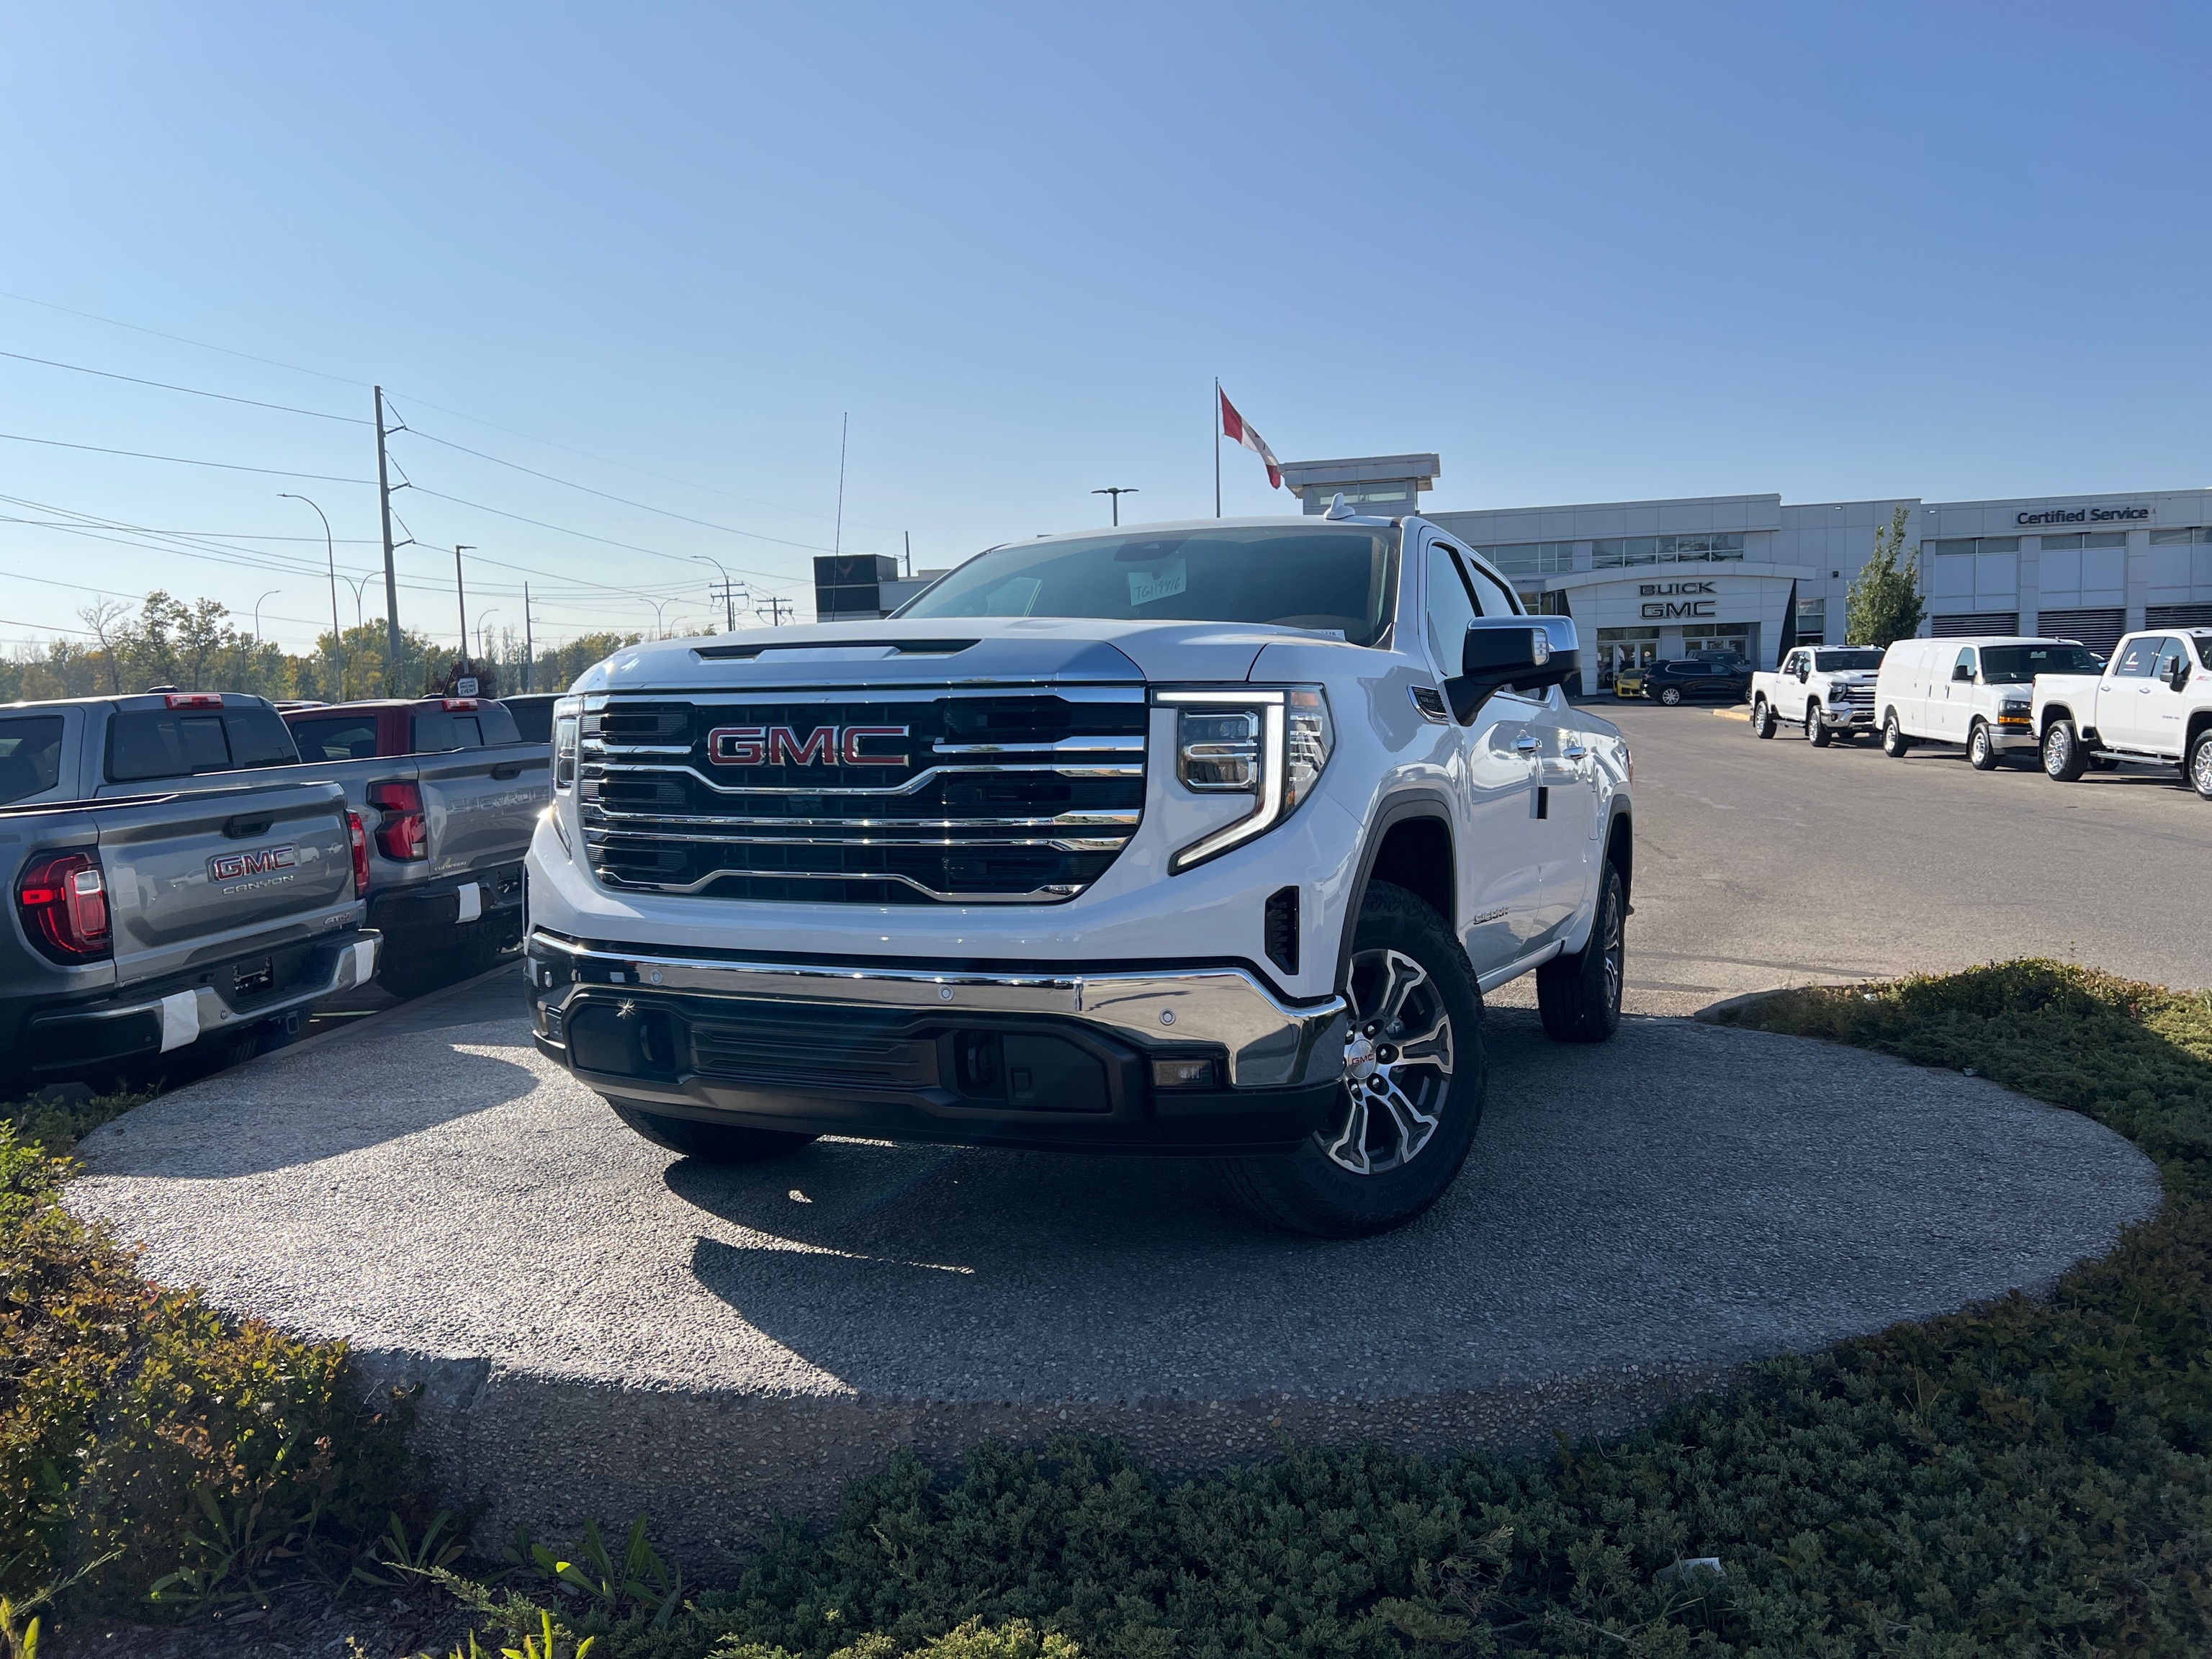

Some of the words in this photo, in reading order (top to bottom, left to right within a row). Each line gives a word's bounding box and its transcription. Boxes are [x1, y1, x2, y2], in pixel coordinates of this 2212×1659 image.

[2017, 509, 2085, 525] Certified
[2090, 507, 2149, 521] Service
[1639, 581, 1717, 596] BUICK
[1641, 601, 1717, 619] GMC
[708, 724, 910, 767] GMC
[214, 846, 297, 881] GMC
[222, 875, 294, 895] CANYON
[1474, 905, 1510, 925] SIERRA
[1352, 1053, 1375, 1065] GMC
